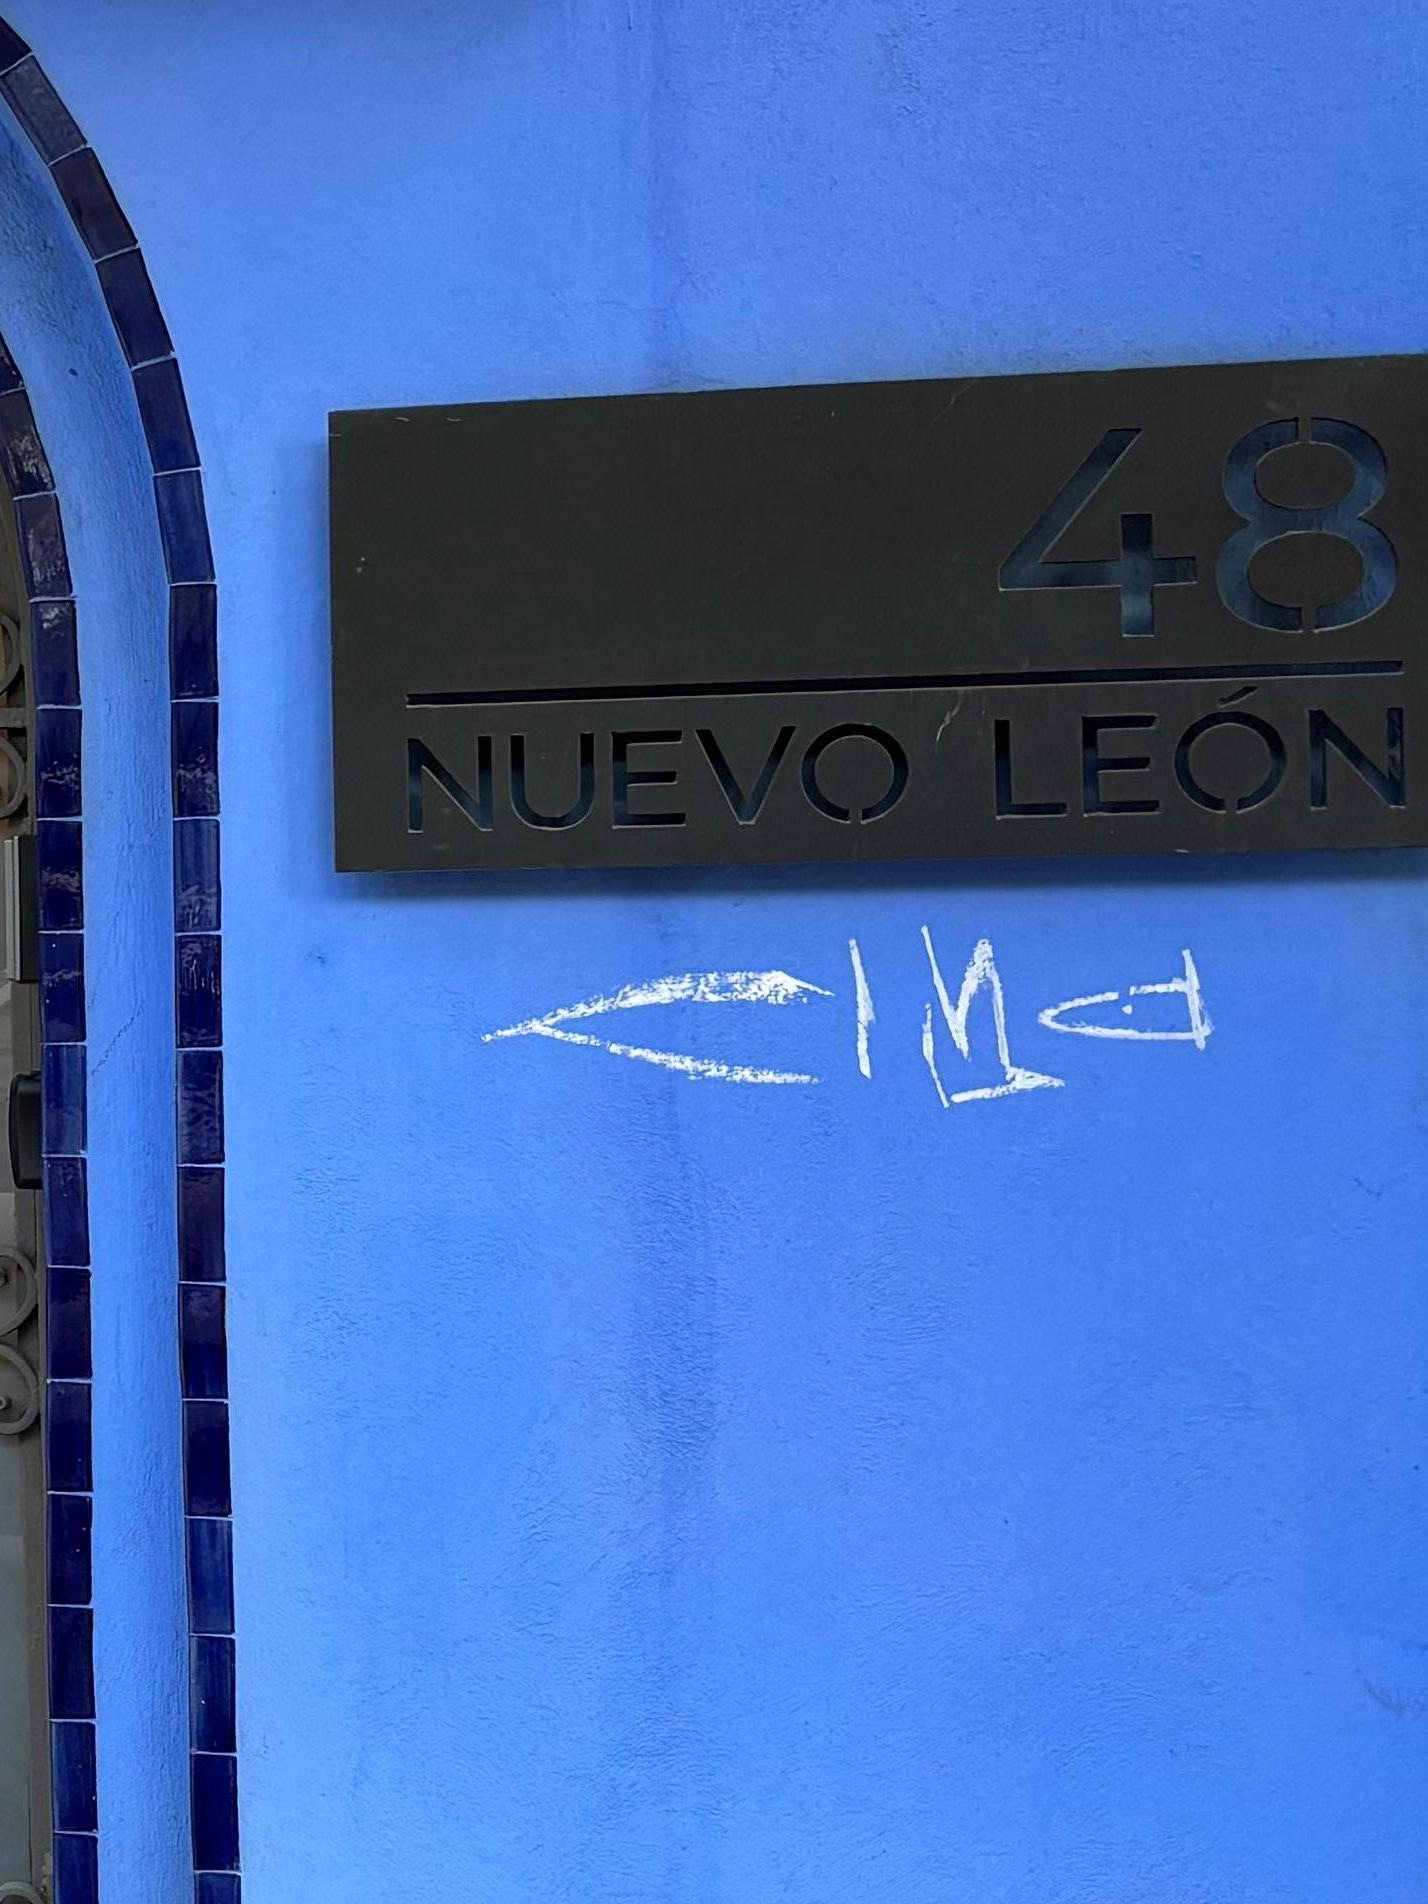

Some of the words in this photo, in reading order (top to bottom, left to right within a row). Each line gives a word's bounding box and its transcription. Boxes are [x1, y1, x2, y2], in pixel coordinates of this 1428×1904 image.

[998, 416, 1400, 638] 48
[405, 720, 911, 834] NUEVO
[992, 685, 1407, 819] LEÓN
